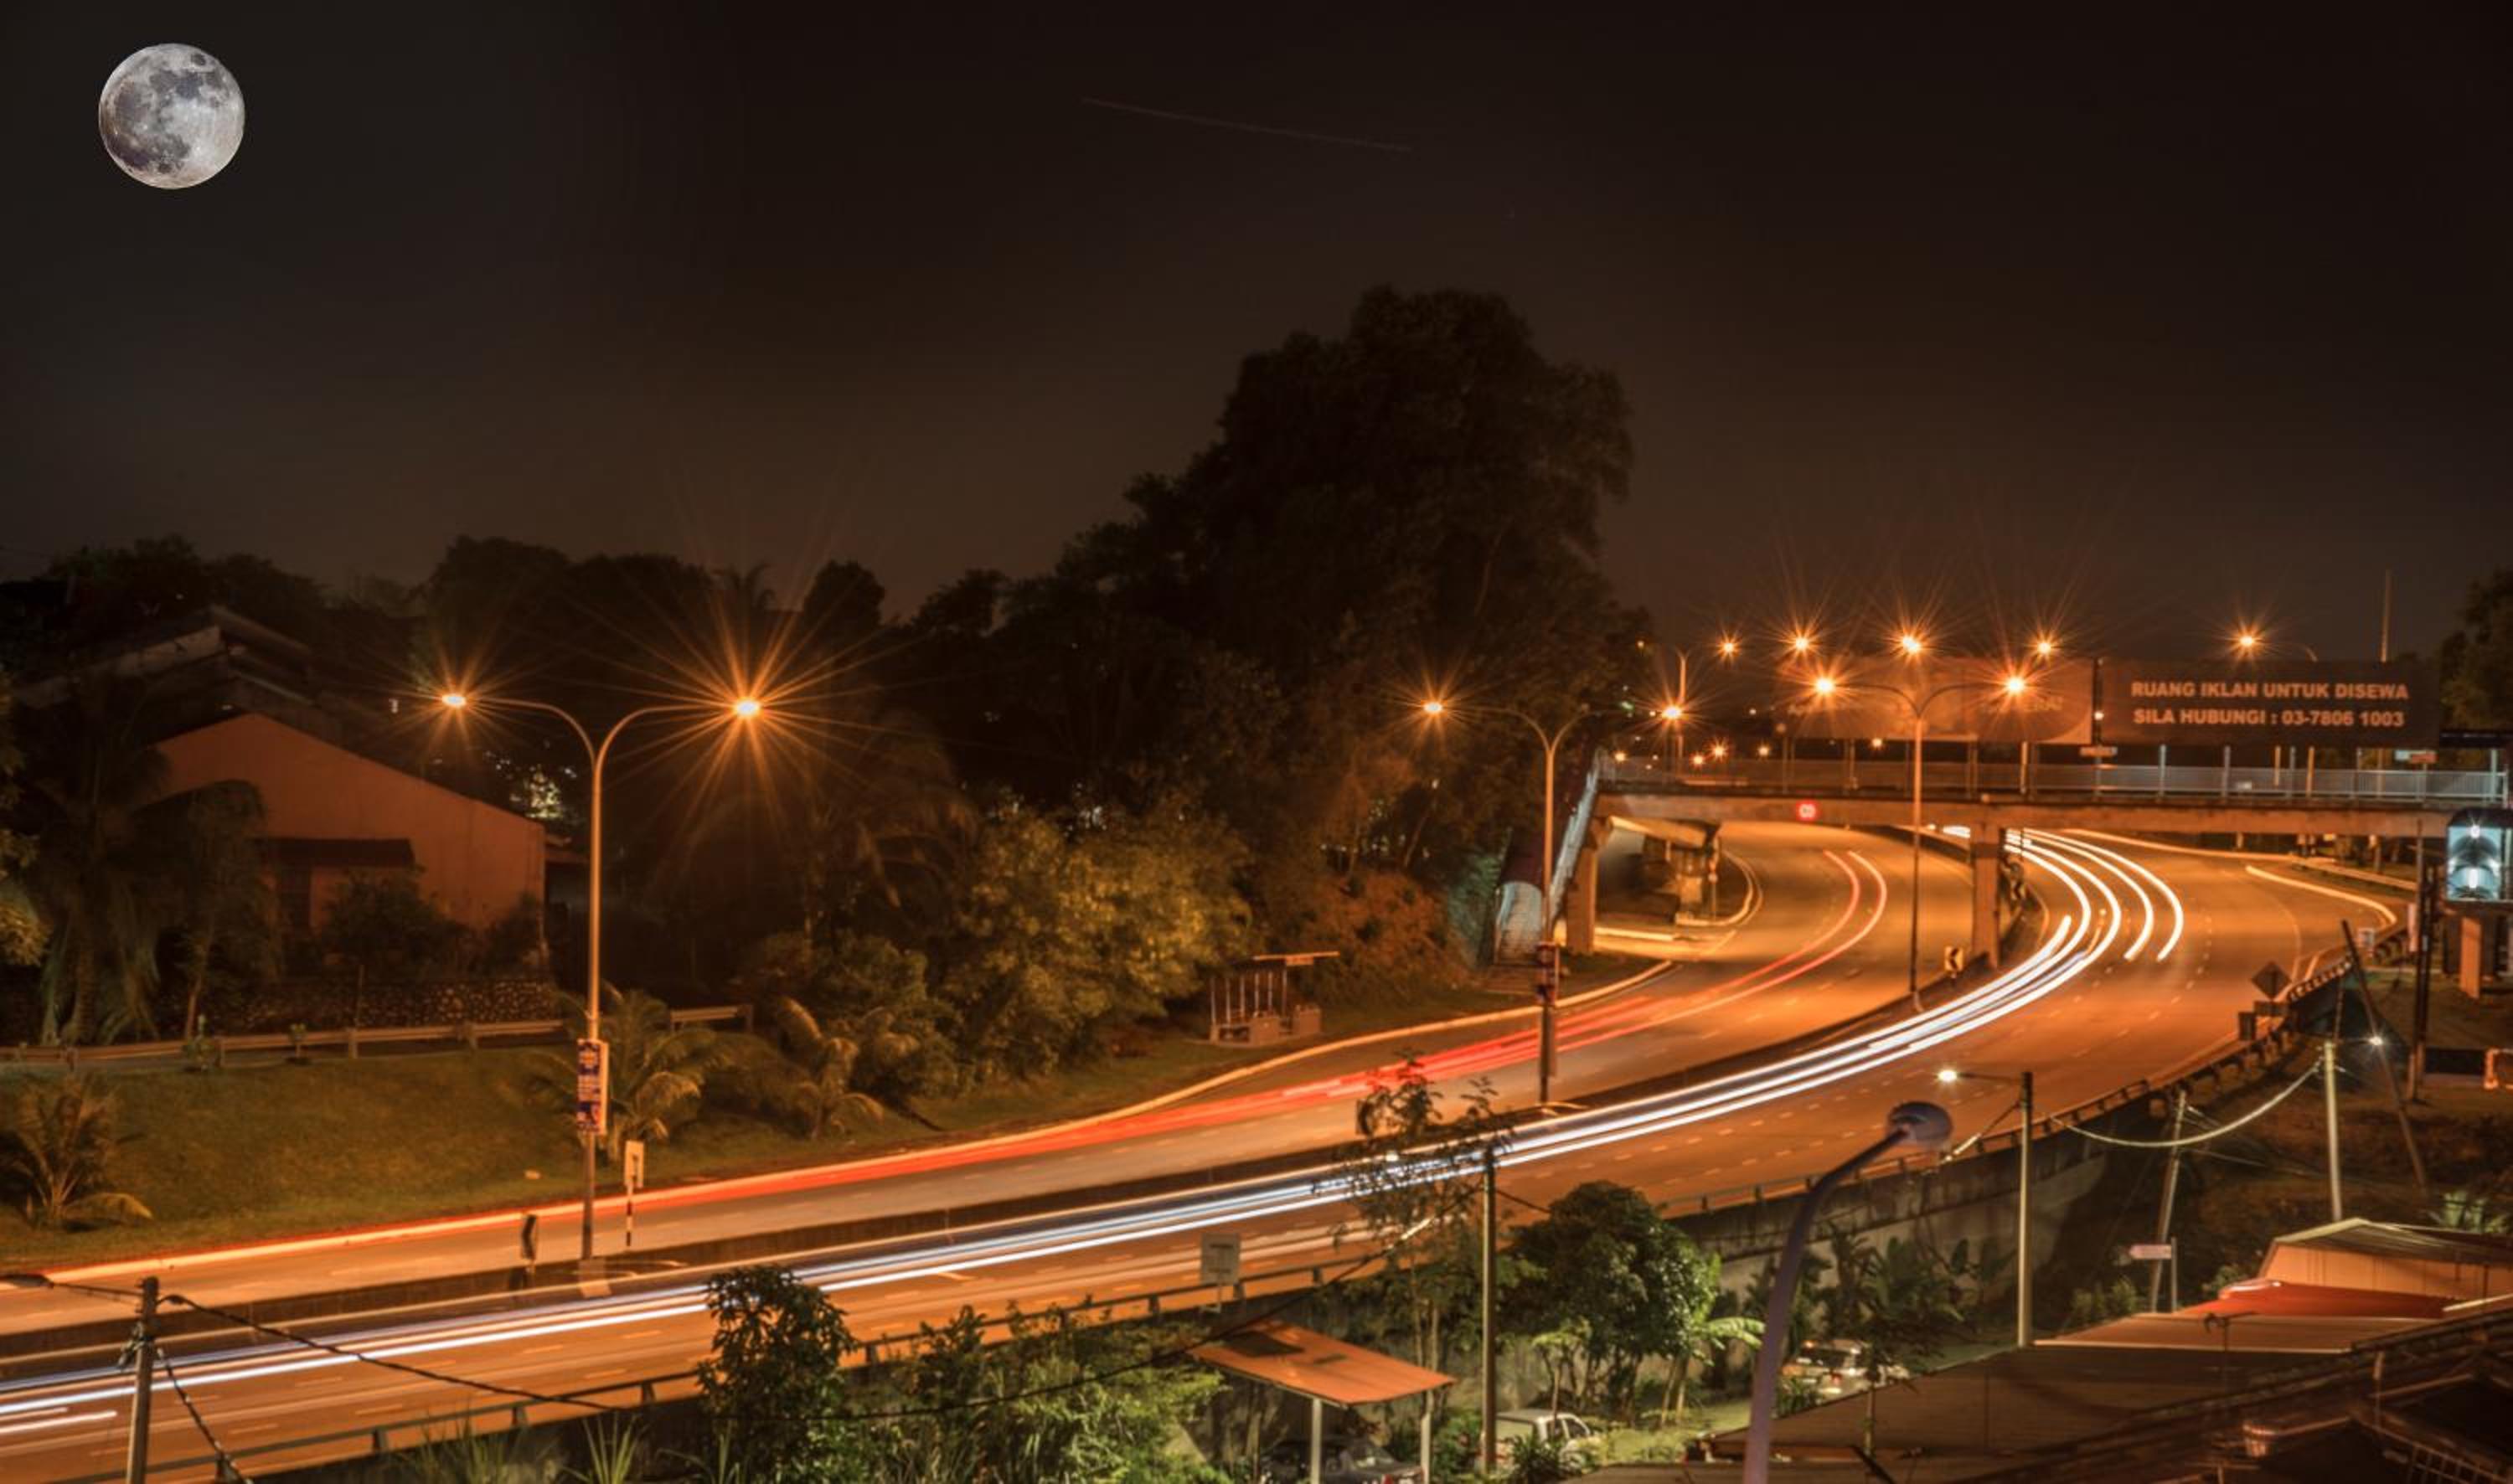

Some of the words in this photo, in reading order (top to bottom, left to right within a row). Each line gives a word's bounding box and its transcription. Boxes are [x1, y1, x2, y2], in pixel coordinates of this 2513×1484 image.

[2131, 683, 2195, 697] RUANG
[2201, 683, 2258, 697] IKLAN
[2263, 683, 2329, 698] UNTUK
[2335, 683, 2409, 698] DISEWA
[2134, 709, 2175, 724] SILA
[2180, 709, 2266, 724] HUBUNGI
[2359, 711, 2405, 726] 1003
